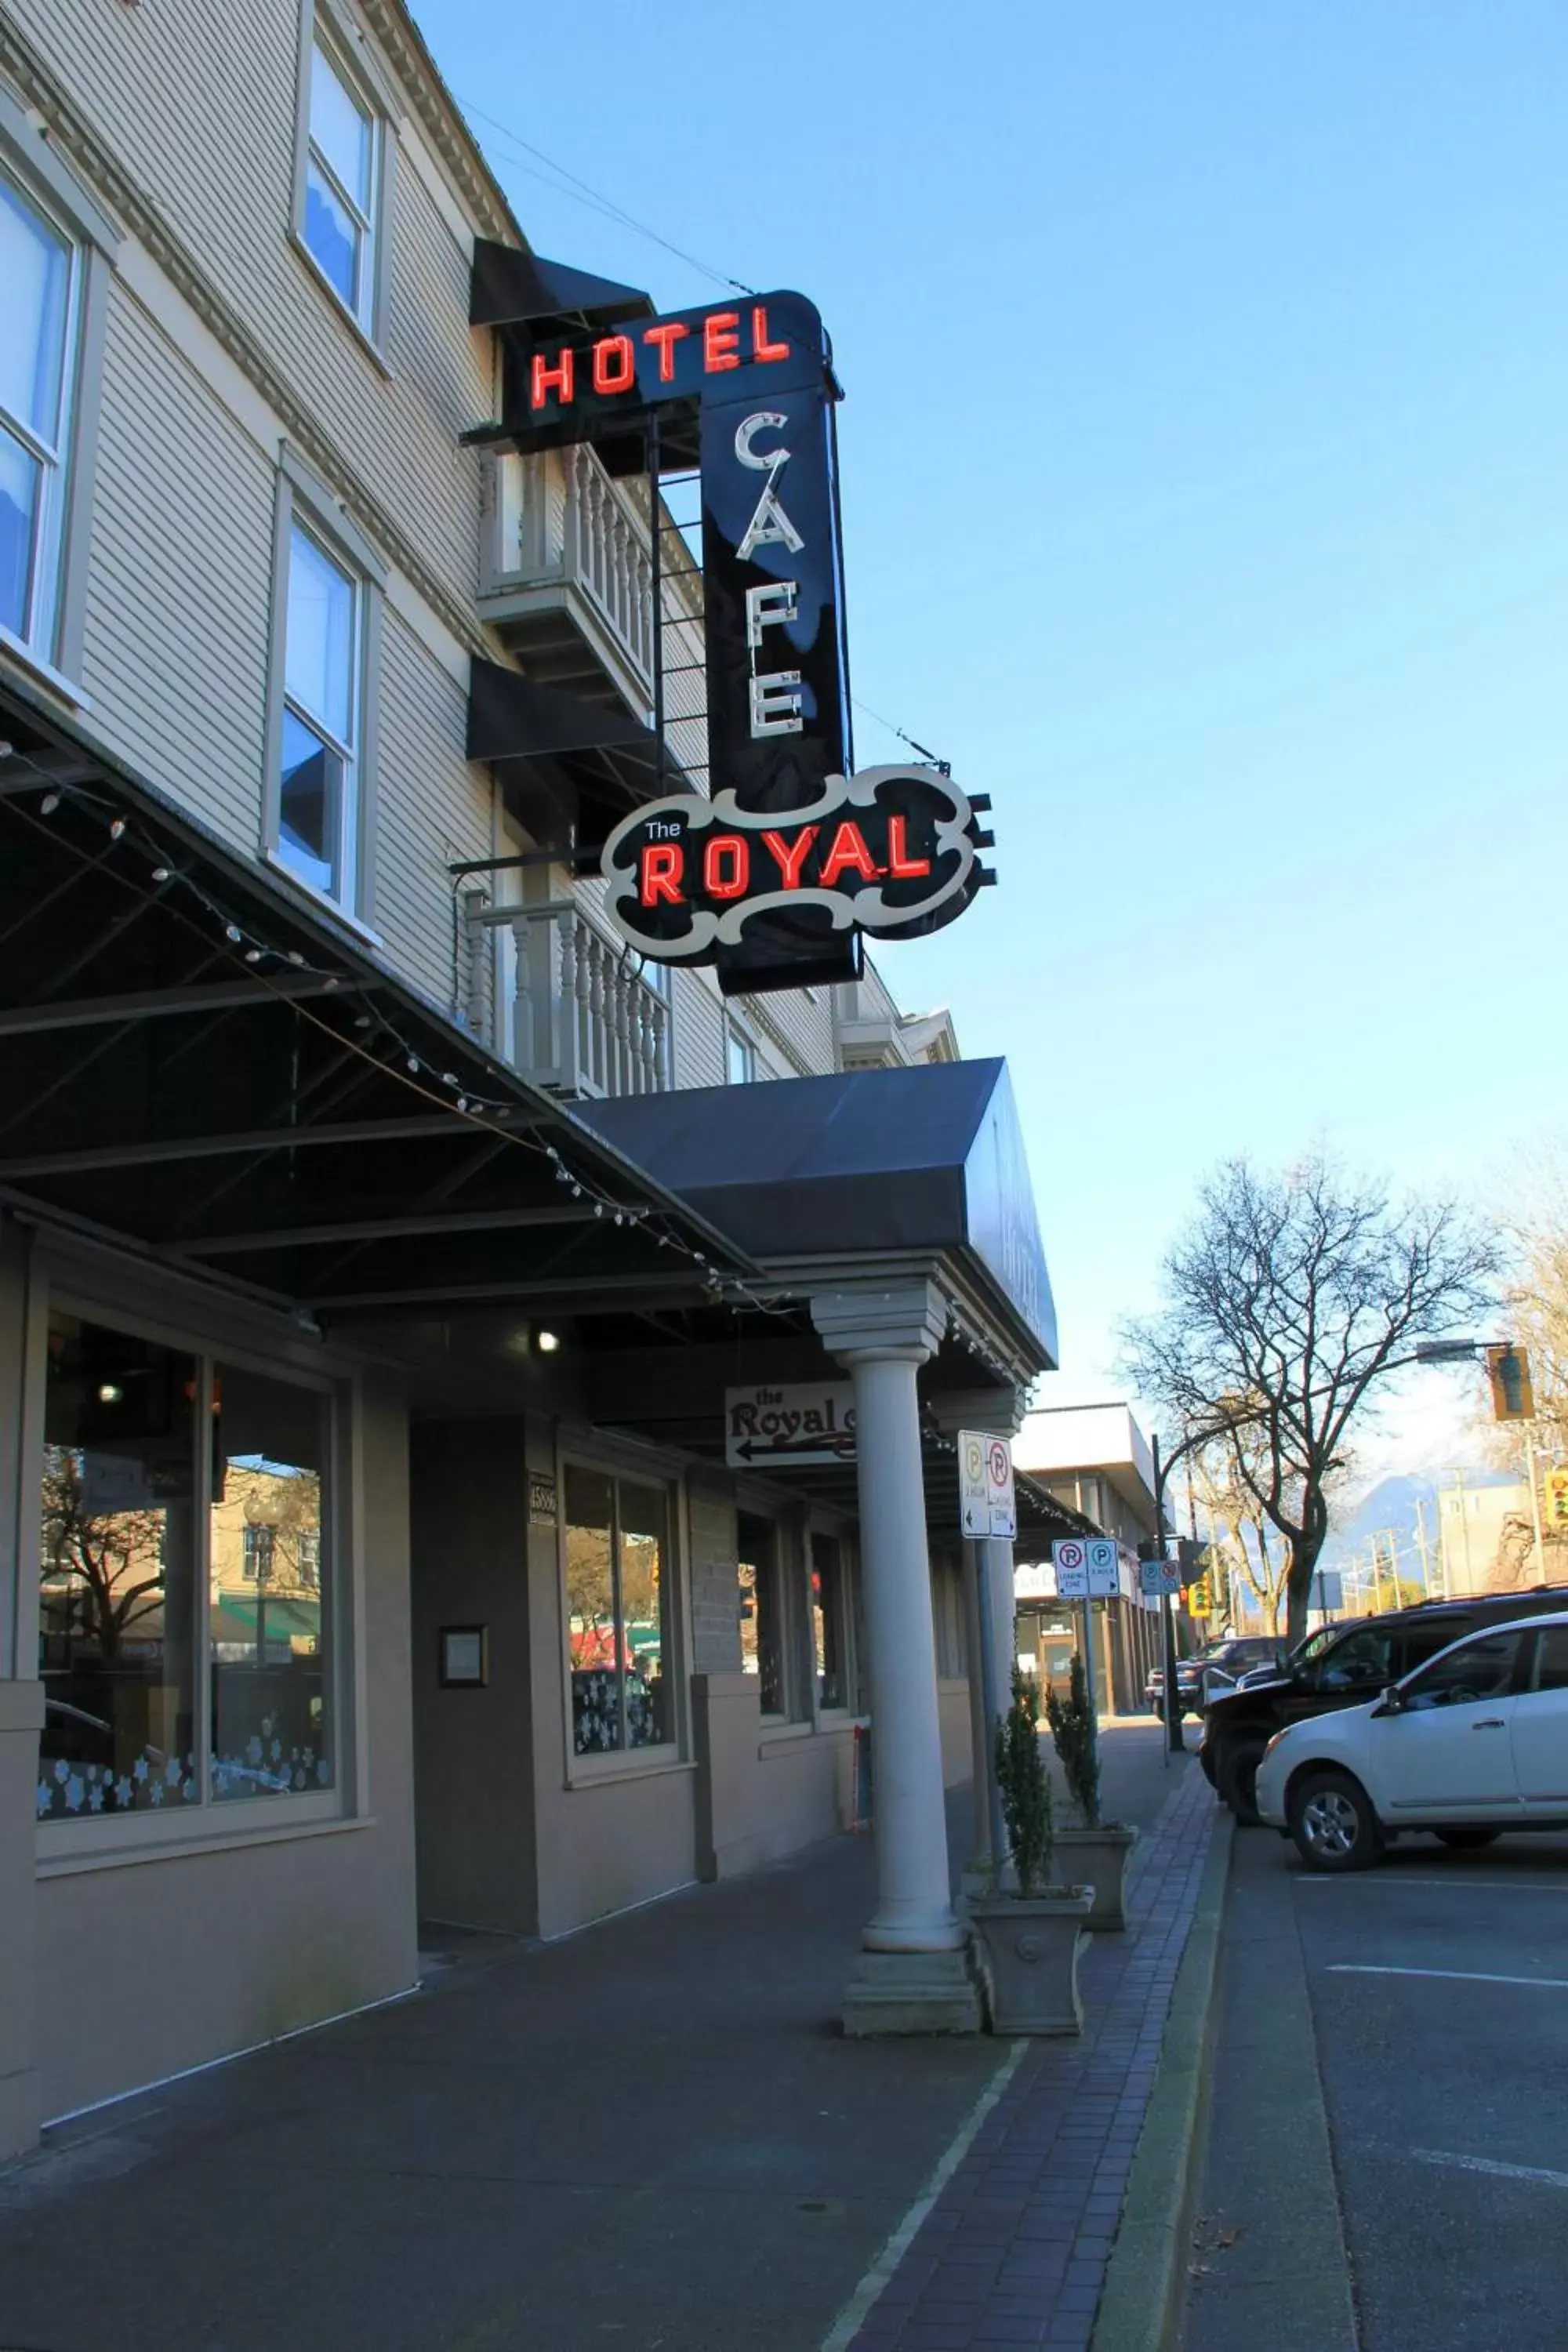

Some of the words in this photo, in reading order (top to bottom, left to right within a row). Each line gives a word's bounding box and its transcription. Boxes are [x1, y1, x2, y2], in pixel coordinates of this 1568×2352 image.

[531, 307, 790, 410] HOTEL
[734, 412, 805, 739] CAFE
[641, 815, 931, 907] ROYAL
[644, 822, 681, 840] The
[729, 1397, 837, 1445] Royal
[756, 1388, 783, 1405] the
